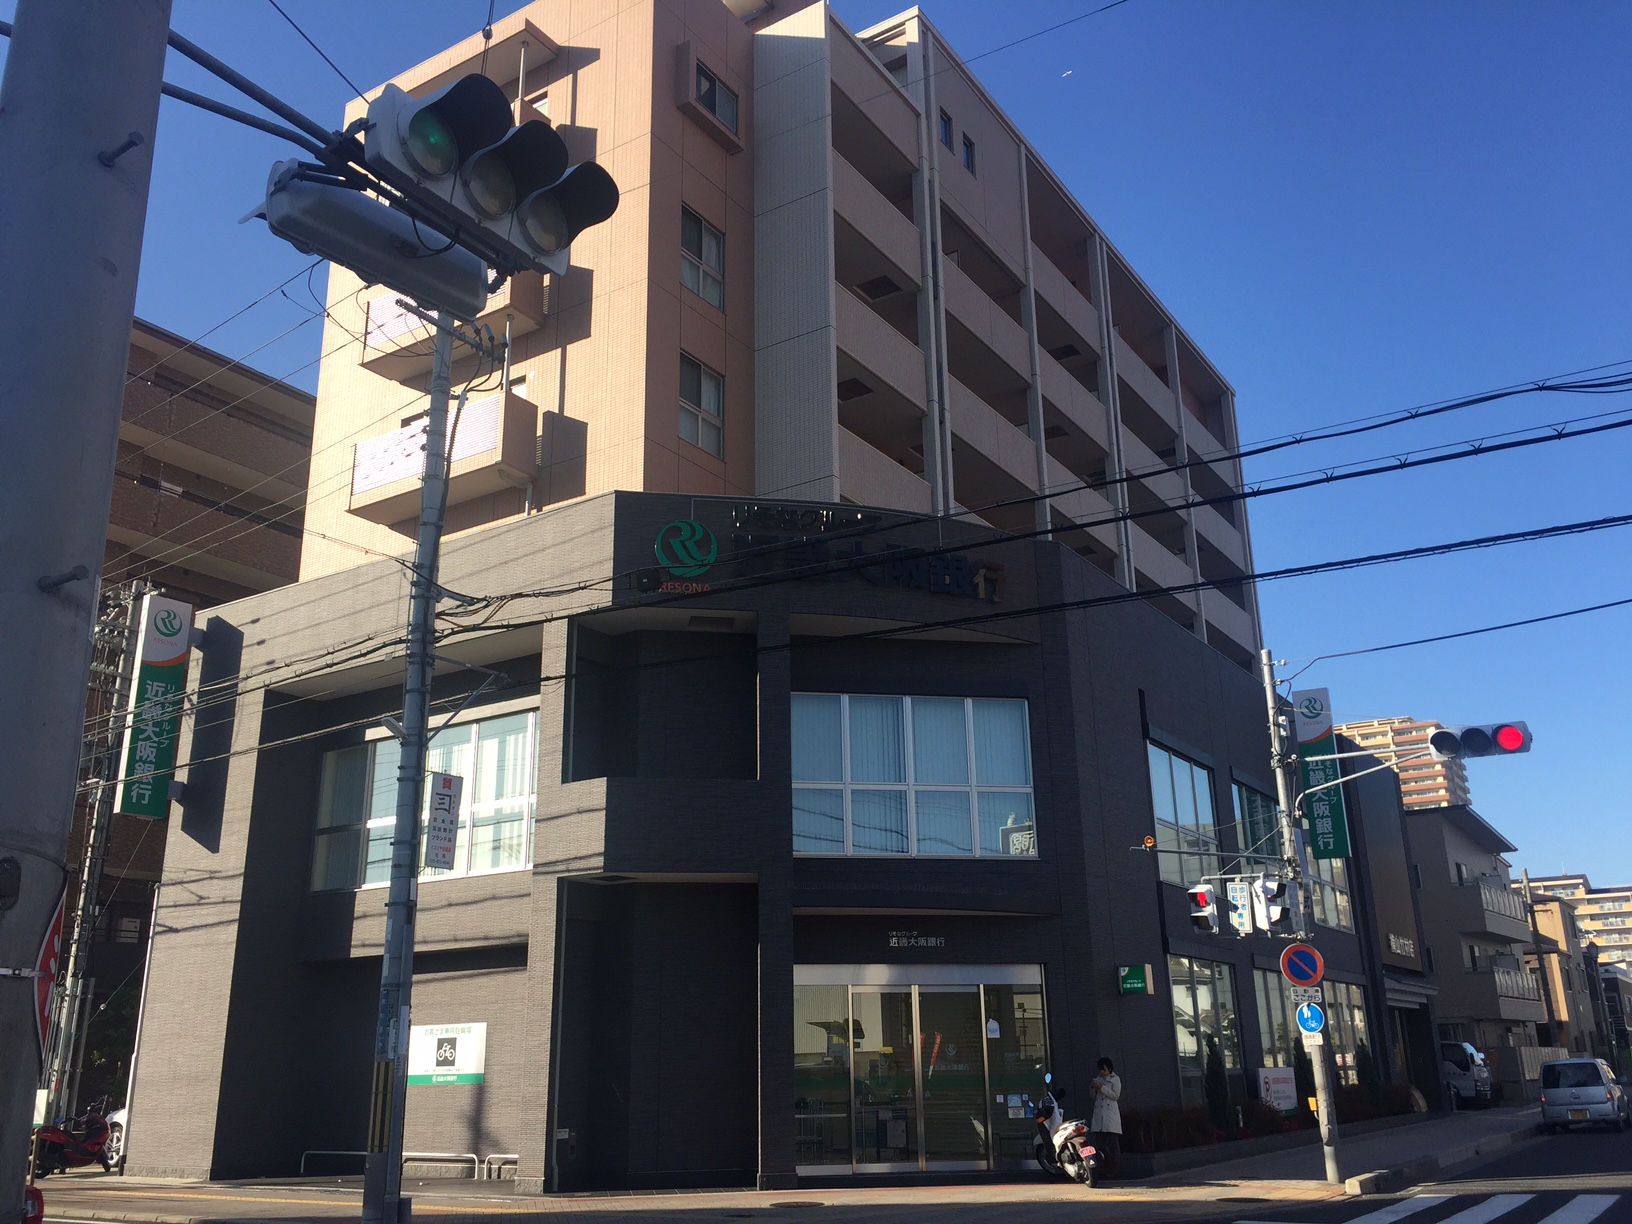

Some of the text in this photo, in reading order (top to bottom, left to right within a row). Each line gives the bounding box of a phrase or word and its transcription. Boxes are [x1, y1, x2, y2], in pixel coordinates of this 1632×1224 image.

[660, 582, 711, 594] RESONA
[160, 684, 175, 749] りなループ
[131, 680, 166, 804] 近畿大阪銀行
[1231, 886, 1239, 909] 自転
[889, 937, 945, 947] 近畿大阪銀行
